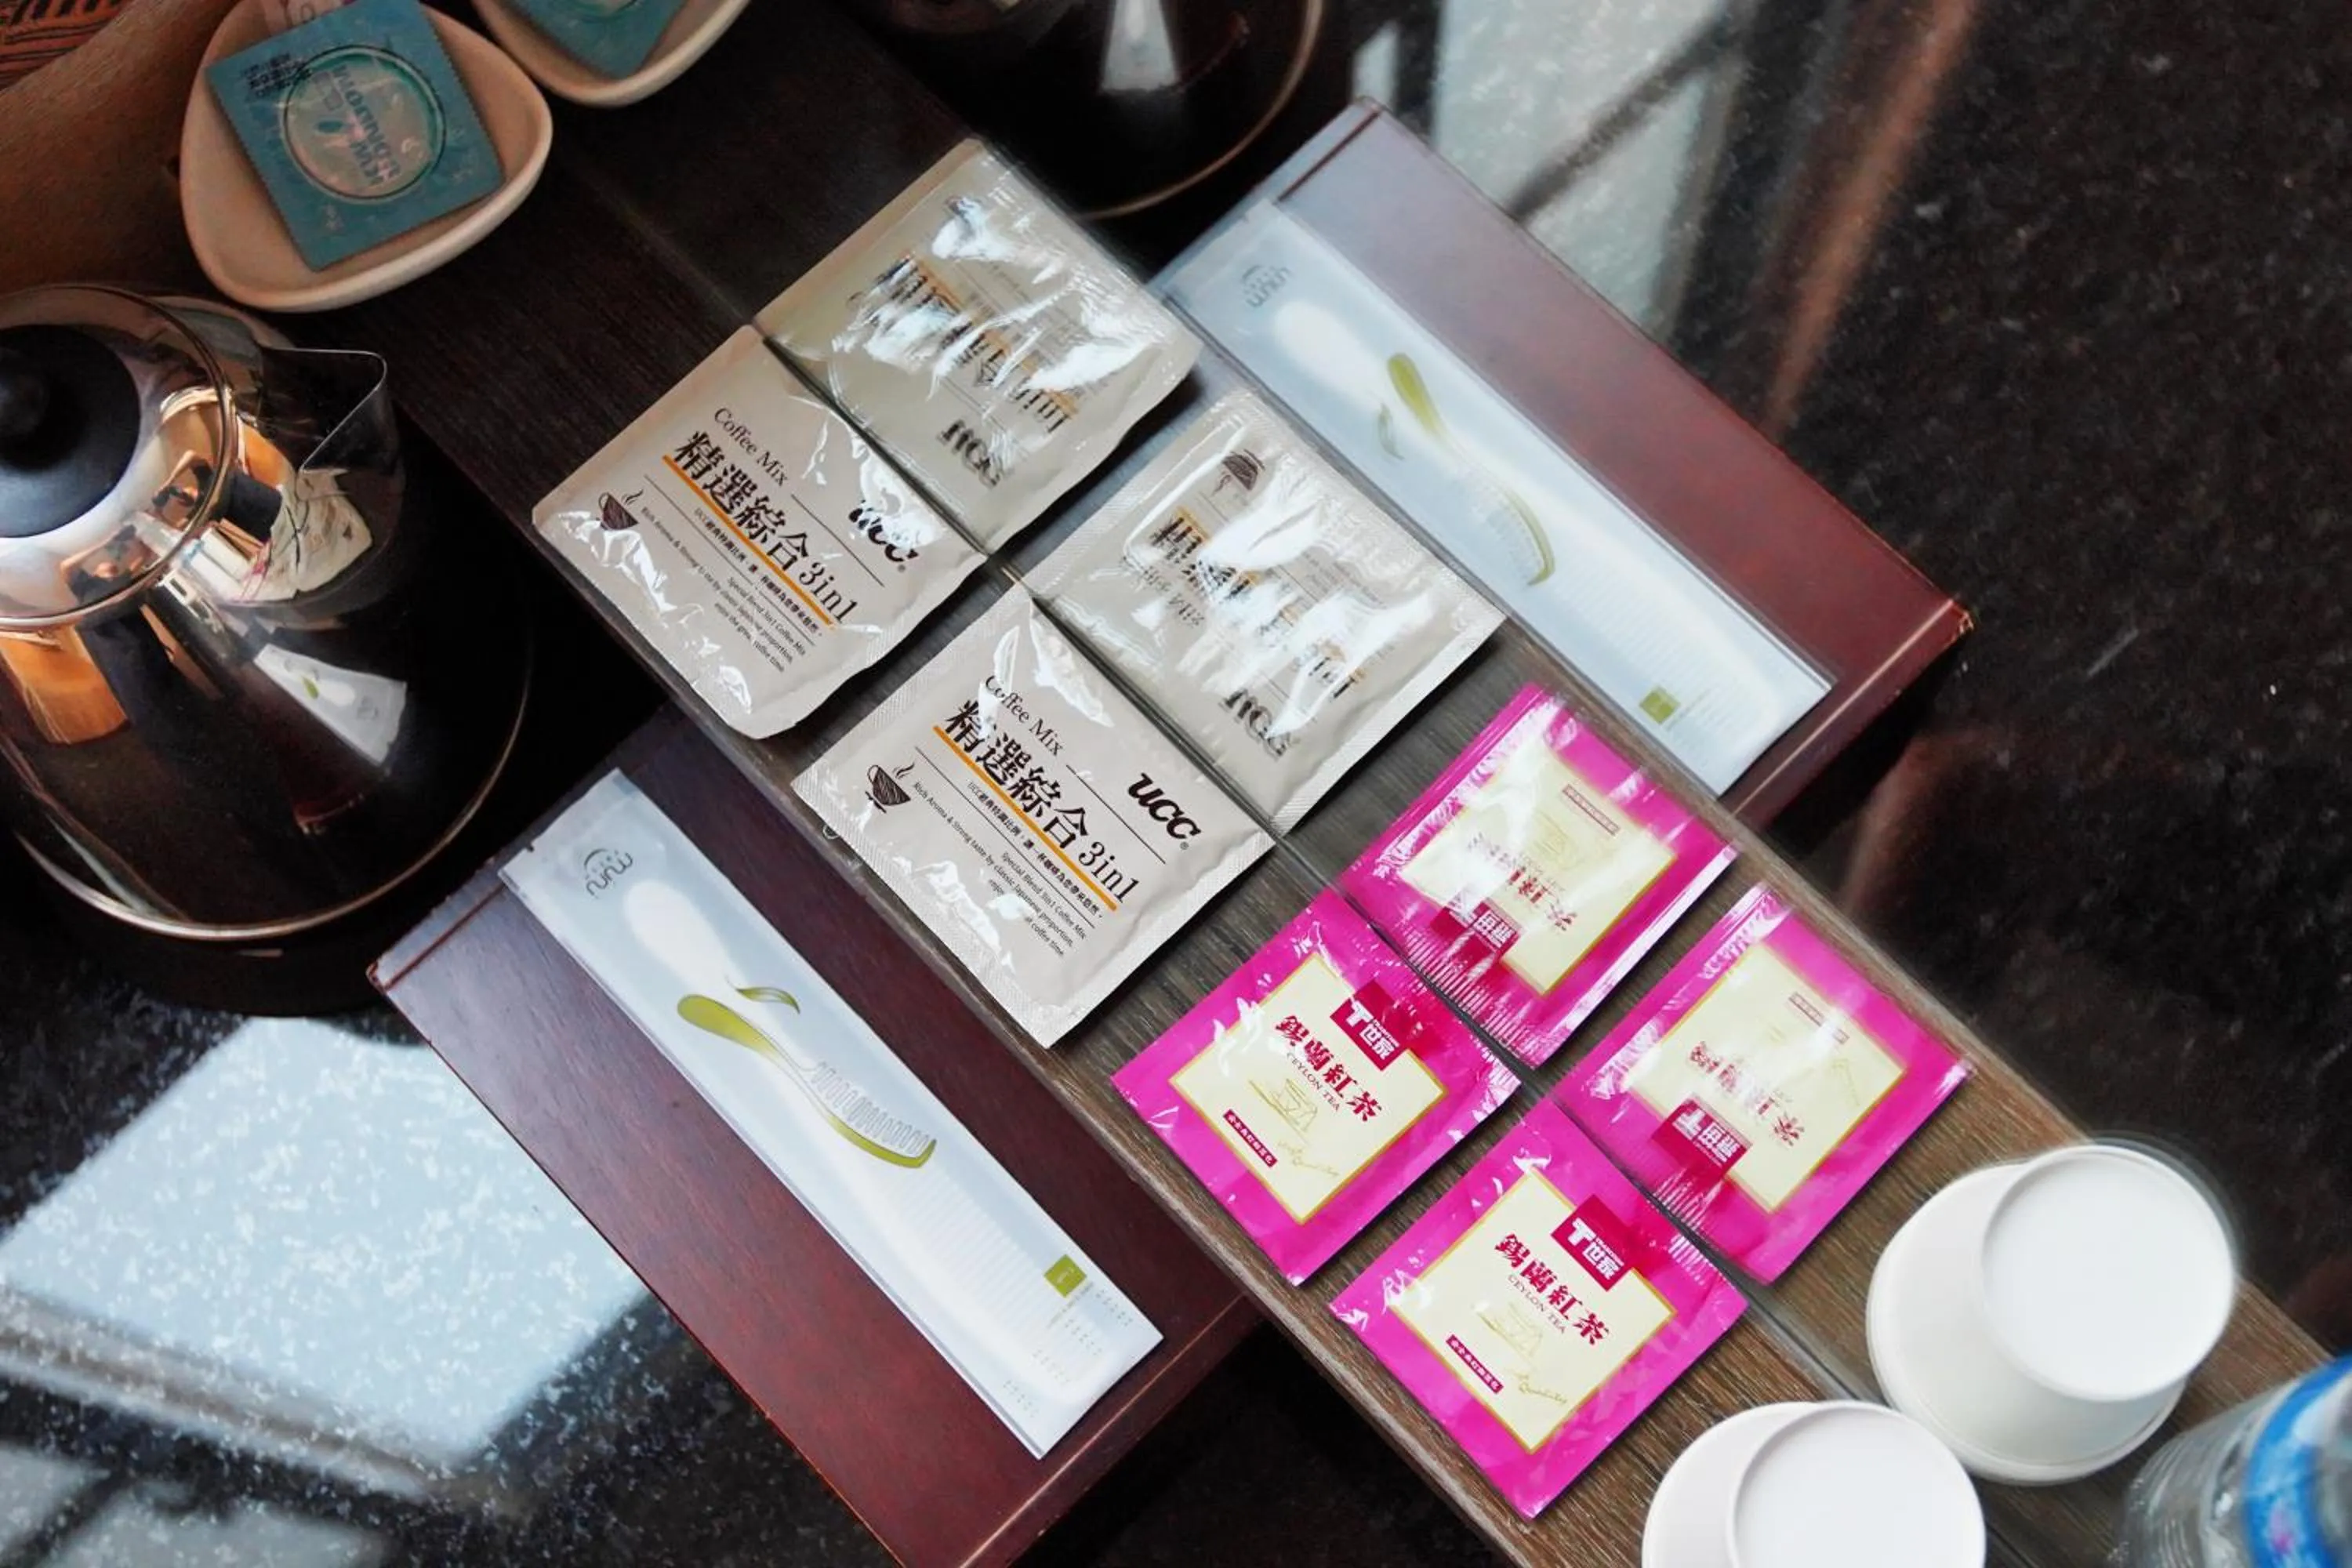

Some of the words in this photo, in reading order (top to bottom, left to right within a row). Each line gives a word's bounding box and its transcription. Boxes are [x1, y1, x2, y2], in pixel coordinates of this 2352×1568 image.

[713, 407, 757, 452] Coffee
[756, 450, 786, 485] Mix
[792, 641, 806, 655] Mix
[985, 674, 1029, 723] Coffee
[1029, 718, 1062, 756] Mix
[912, 781, 929, 799] Rich
[925, 795, 949, 819] Aroma
[950, 820, 973, 844] Strong
[969, 839, 987, 857] taste
[983, 853, 996, 867] by
[992, 863, 1016, 887] classic
[1000, 851, 1025, 877] Special
[1053, 904, 1075, 927] Coffee
[1073, 923, 1087, 941] Mix
[1029, 921, 1051, 943] coffee
[1276, 1015, 1381, 1120] 錫蘭紅茶
[1287, 1052, 1323, 1090] CEYLON
[1322, 1090, 1340, 1111] TEA
[1495, 1234, 1607, 1344] 錫蘭紅茶
[1508, 1273, 1544, 1312] CEYLON
[1548, 1312, 1566, 1334] TEA
